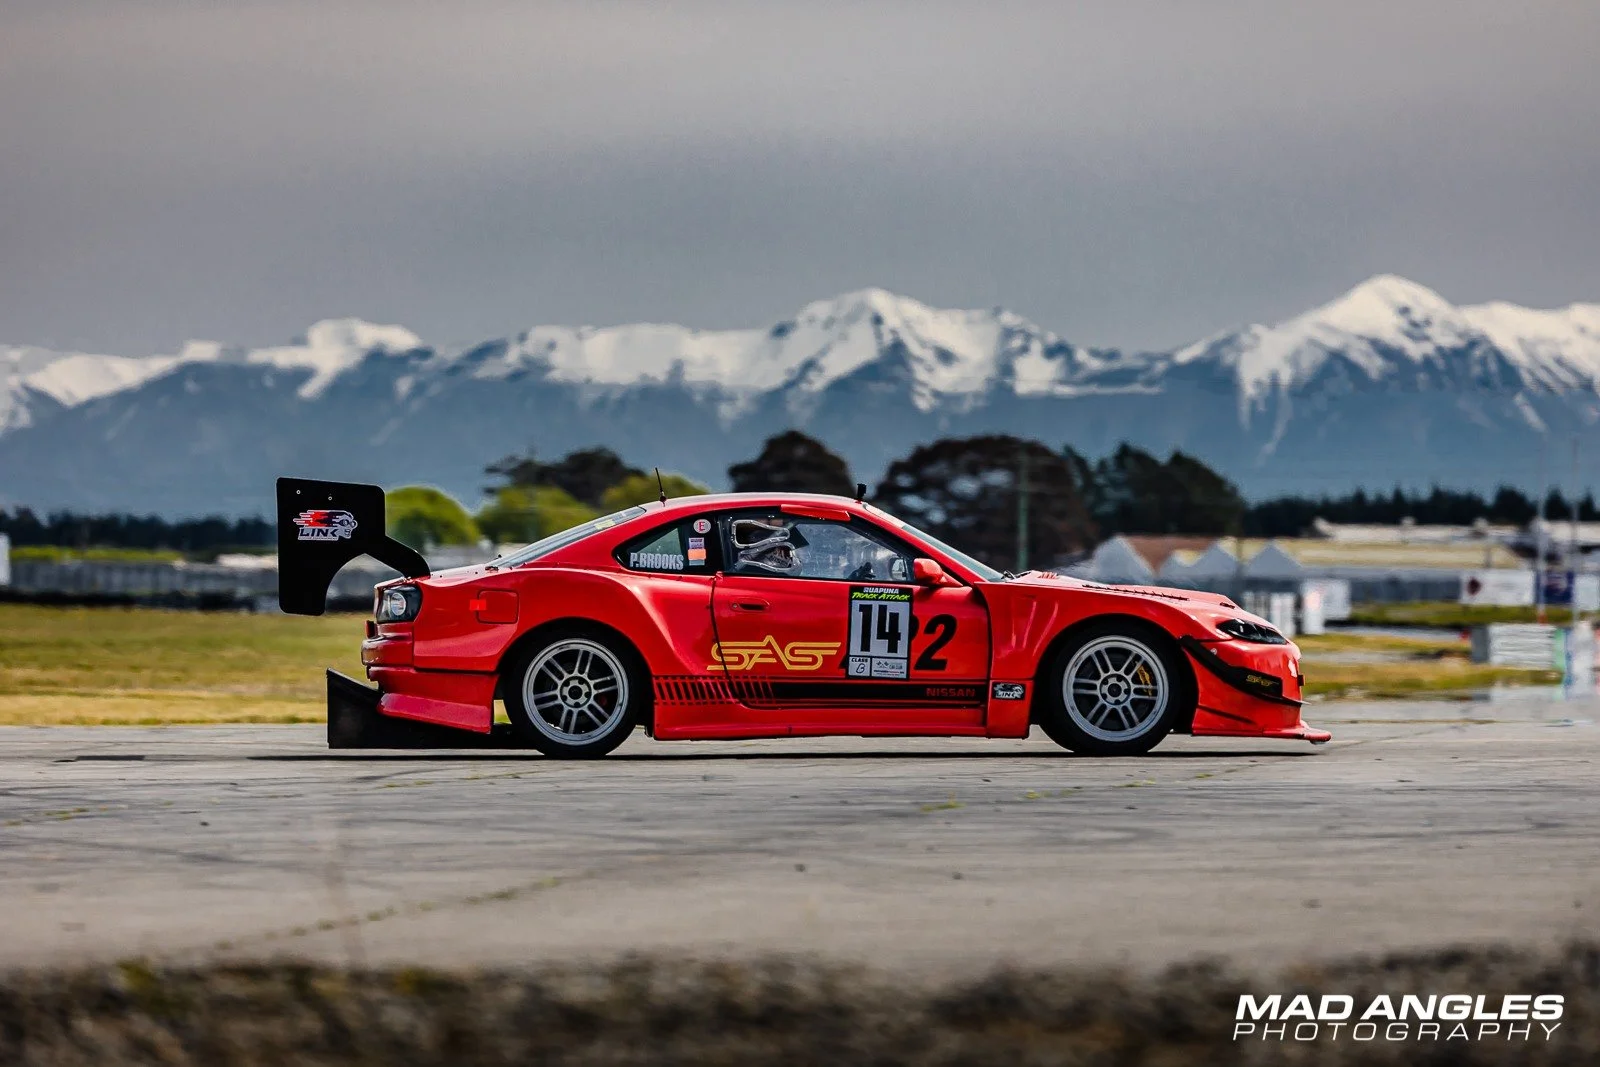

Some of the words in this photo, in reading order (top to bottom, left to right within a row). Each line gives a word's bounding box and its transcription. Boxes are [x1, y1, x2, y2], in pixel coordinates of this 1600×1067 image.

[299, 528, 338, 537] LINK
[698, 521, 706, 531] E
[629, 552, 684, 570] P.BROOKS
[858, 604, 902, 653] 14
[706, 634, 841, 671] SAS
[925, 687, 976, 697] NISSAN
